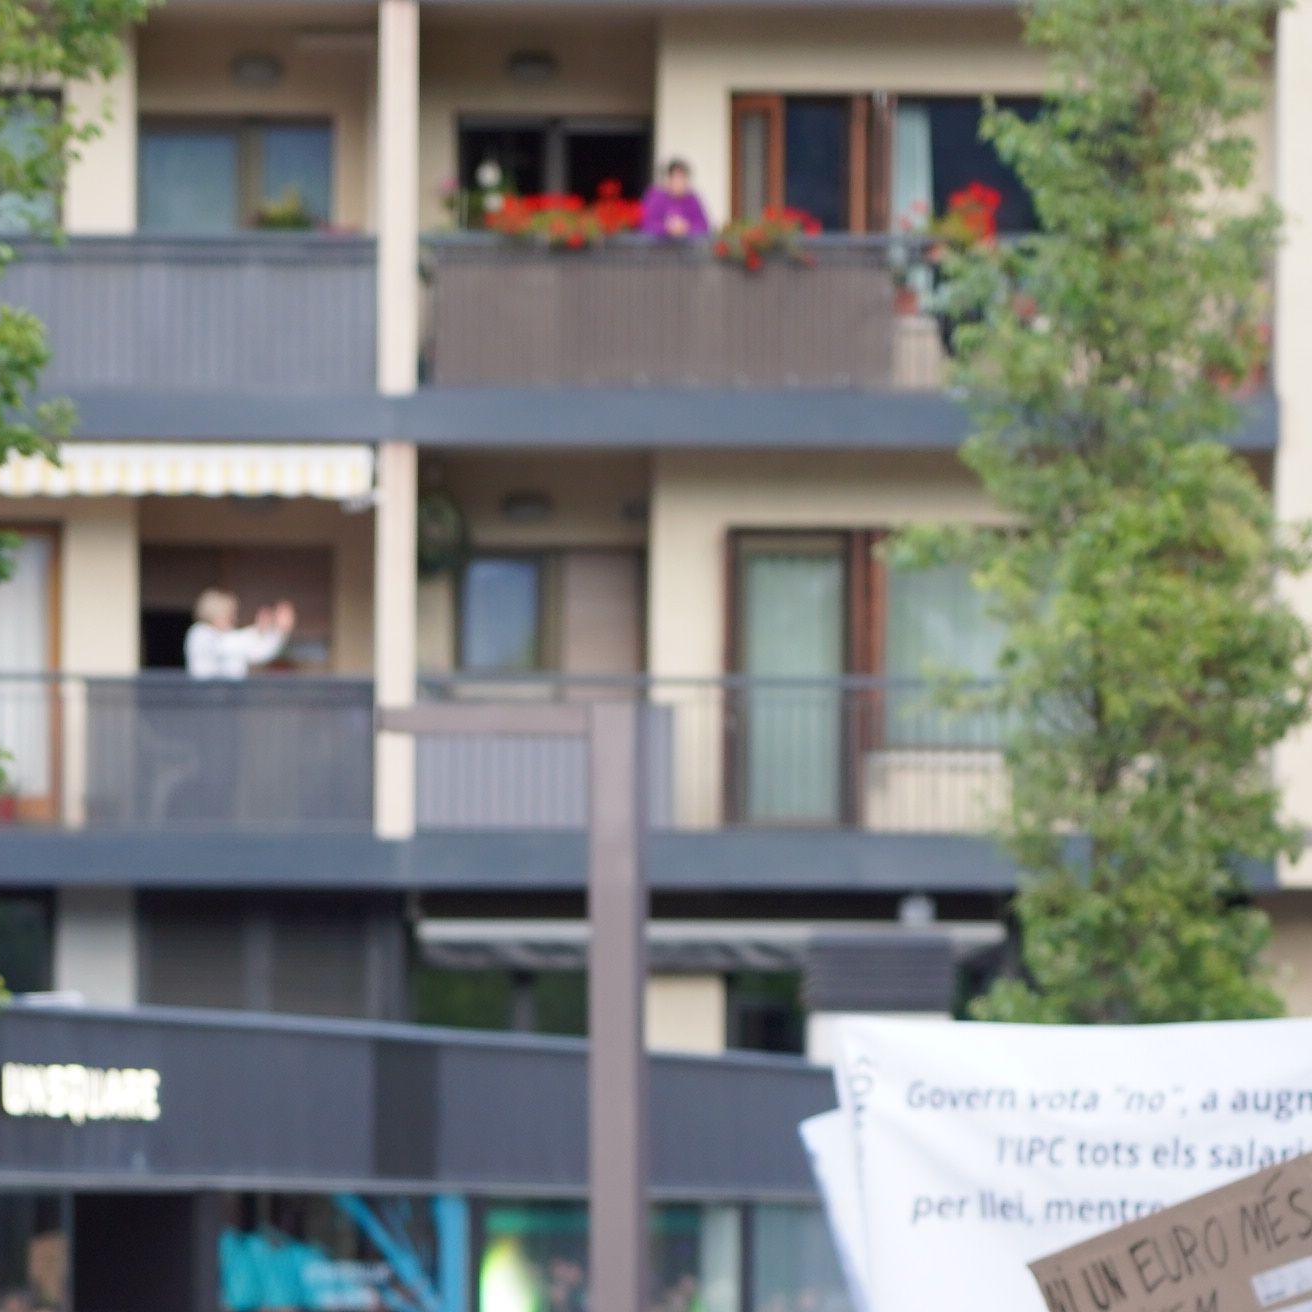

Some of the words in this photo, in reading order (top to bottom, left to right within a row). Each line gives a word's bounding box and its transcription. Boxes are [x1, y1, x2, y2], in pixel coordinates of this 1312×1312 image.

[905, 1079, 1017, 1112] Govern
[1028, 1086, 1101, 1113] vota
[1201, 1089, 1218, 1112] a
[1076, 1138, 1141, 1168] tots
[1152, 1135, 1195, 1168] els
[910, 1196, 970, 1226] per
[978, 1189, 1034, 1225] llei,
[1081, 1257, 1128, 1312] UN
[1128, 1216, 1230, 1294] EURO
